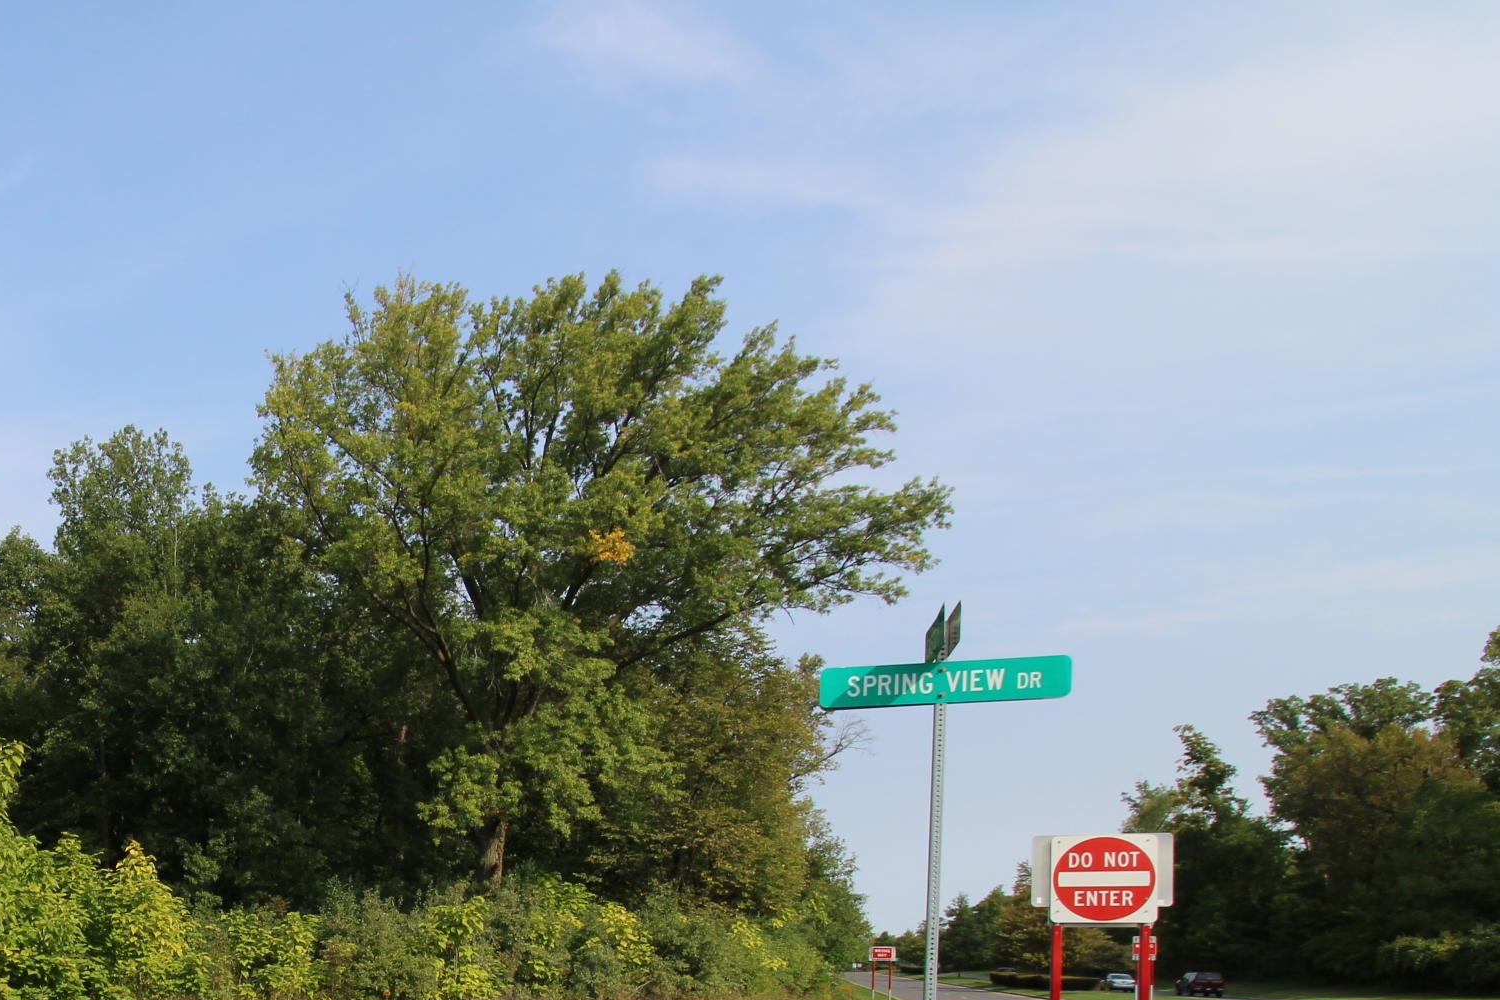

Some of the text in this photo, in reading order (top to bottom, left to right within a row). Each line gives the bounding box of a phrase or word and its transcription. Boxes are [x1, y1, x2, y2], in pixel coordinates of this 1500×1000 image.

[847, 668, 1042, 697] SPRING VIEW DR
[1068, 851, 1140, 868] DO NOT
[1074, 890, 1134, 907] ENTER
